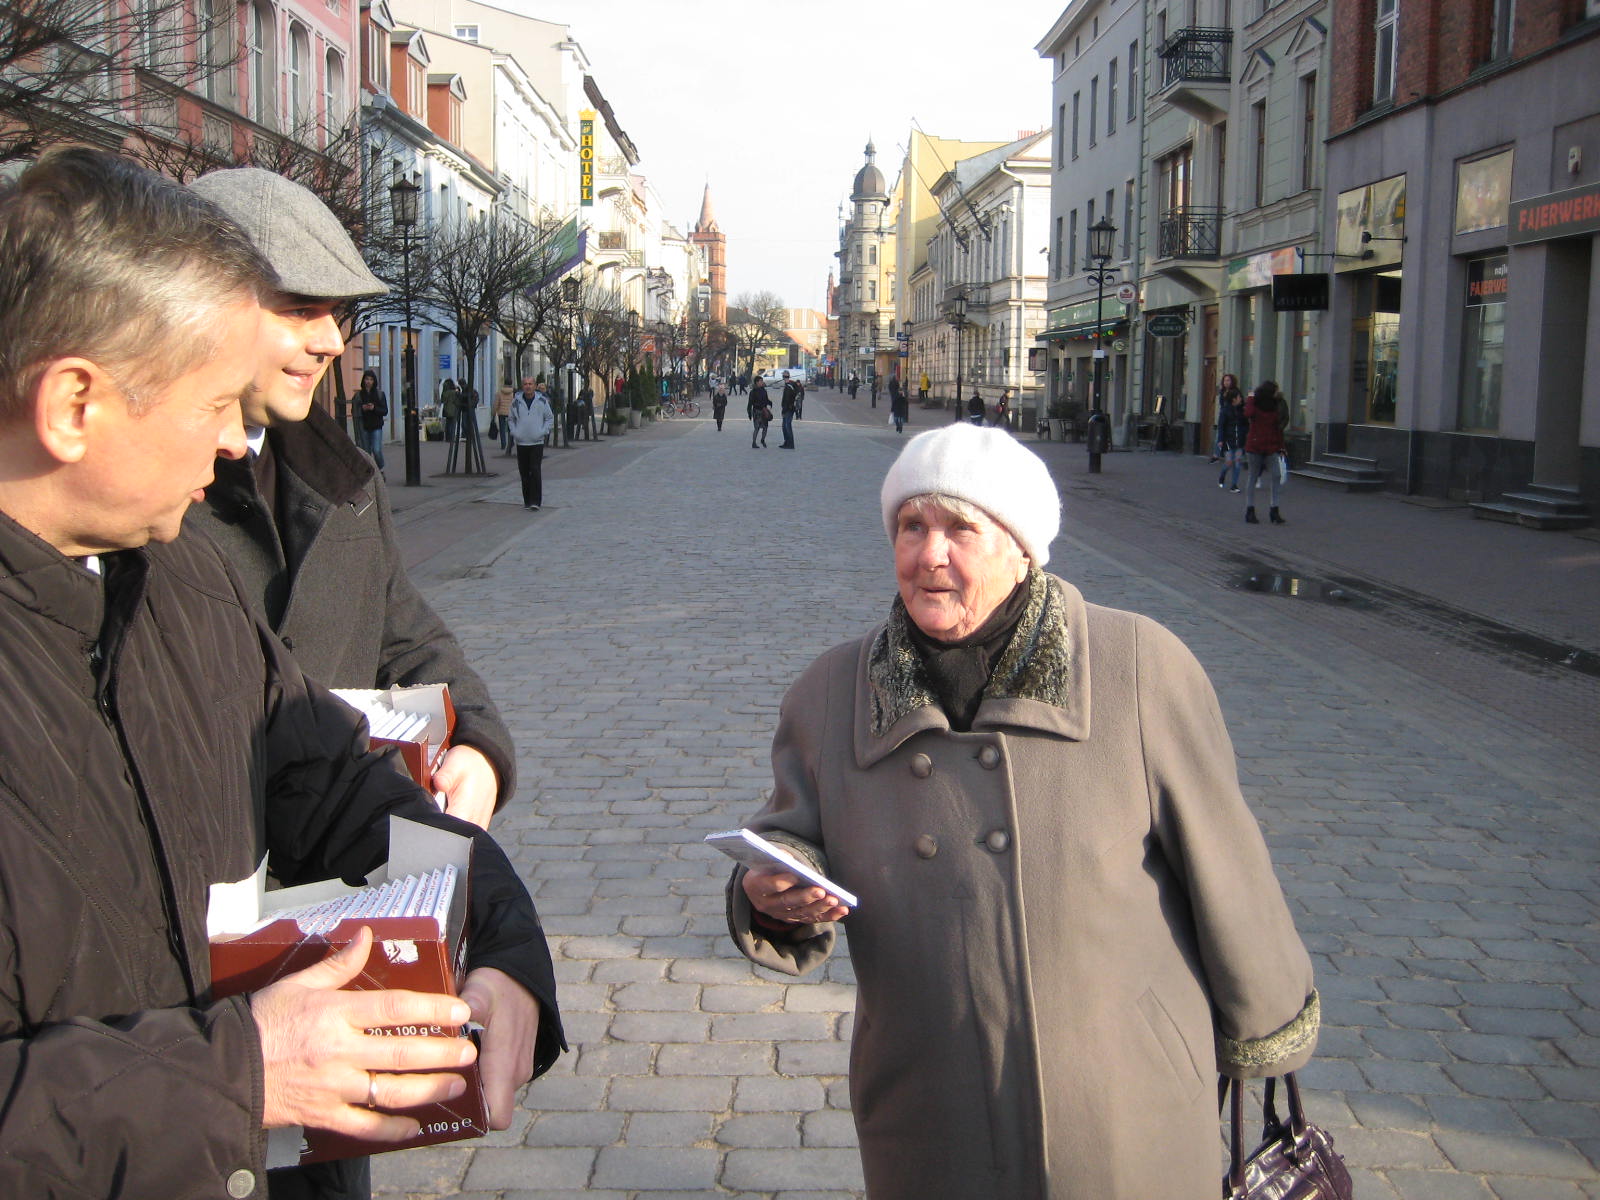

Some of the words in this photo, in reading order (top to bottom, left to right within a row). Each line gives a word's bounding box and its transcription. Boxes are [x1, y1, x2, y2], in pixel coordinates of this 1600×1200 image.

[580, 134, 594, 200] HOTEL
[395, 1025, 417, 1036] 100
[420, 1027, 428, 1037] g
[427, 1121, 448, 1133] 100
[451, 1121, 459, 1132] g
